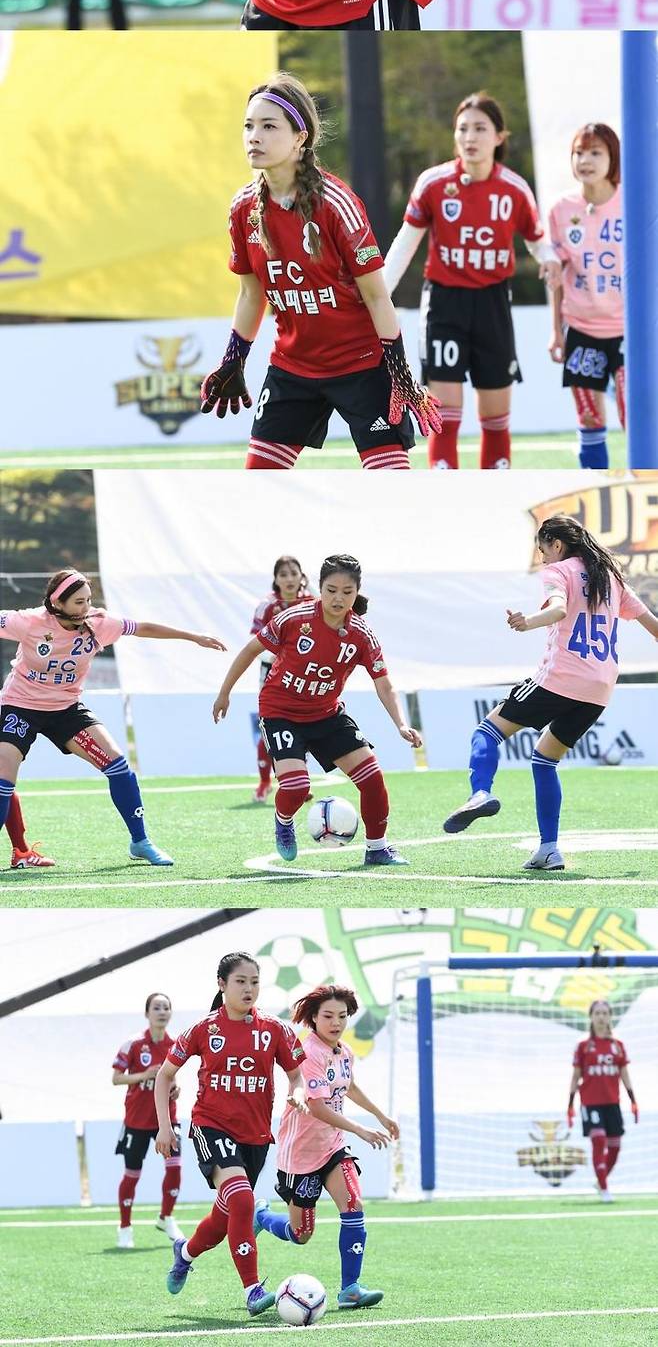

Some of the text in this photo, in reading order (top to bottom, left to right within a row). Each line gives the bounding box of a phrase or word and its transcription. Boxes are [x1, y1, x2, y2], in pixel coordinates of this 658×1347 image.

[488, 193, 513, 222] 10
[459, 226, 495, 247] FC
[599, 218, 623, 243] 45
[583, 251, 616, 270] FC
[266, 260, 304, 285] FC
[432, 339, 460, 368] 10
[566, 346, 608, 378] 452
[255, 387, 271, 421] 8
[369, 424, 391, 432] adidas
[71, 637, 97, 656] 23
[336, 641, 358, 664] 19
[47, 659, 77, 673] FC
[304, 662, 334, 679] FC
[2, 713, 30, 738] 23
[272, 730, 294, 751] 19
[252, 1030, 272, 1052] 19
[226, 1056, 256, 1072] FC
[210, 1074, 231, 1092] 국대
[126, 1133, 133, 1149] 1
[214, 1137, 238, 1159] 19
